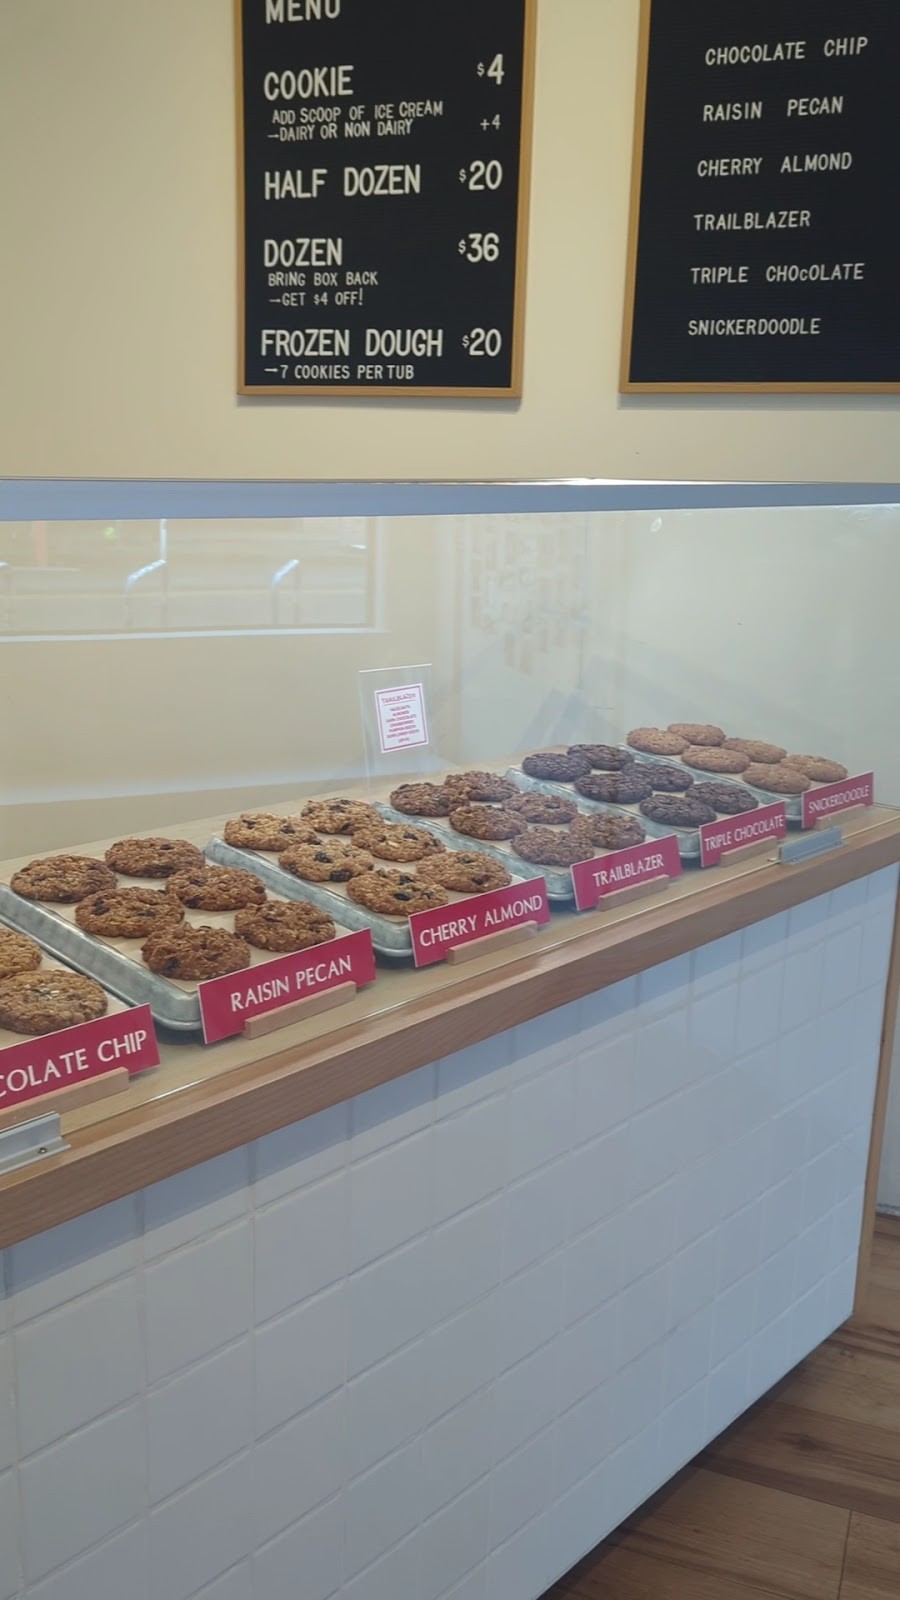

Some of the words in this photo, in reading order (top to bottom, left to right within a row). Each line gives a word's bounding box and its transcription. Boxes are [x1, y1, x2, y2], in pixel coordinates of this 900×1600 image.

[265, 0, 341, 24] MENU
[704, 40, 806, 66] CHOCOLATE
[823, 36, 869, 57] CHIP
[263, 64, 354, 101] COOKIE
[476, 53, 505, 85] $4
[271, 109, 296, 125] ADD
[299, 106, 342, 123] SCOOP
[348, 104, 366, 121] OF
[374, 103, 395, 120] ICE
[398, 99, 444, 118] CREAM
[702, 101, 763, 122] RAISIN
[786, 95, 844, 117] PECAN
[319, 122, 338, 140] OR
[344, 120, 371, 138] NON
[377, 118, 414, 137] DAIRY
[479, 114, 501, 131] +4
[697, 157, 763, 178] CHERRY
[780, 151, 853, 174] ALMOND
[264, 168, 328, 201] HALF
[343, 163, 421, 197] DOZEN
[459, 159, 503, 191] $20
[693, 210, 811, 231] TRAILBLAZER
[264, 237, 343, 268] DOZEN
[458, 232, 500, 263] $36
[268, 271, 306, 287] BRING
[313, 272, 338, 287] BOX
[345, 270, 379, 286] BACK
[690, 266, 749, 285] TRIPLE
[313, 291, 329, 306] $4
[334, 287, 364, 306] OFF!
[688, 317, 821, 336] SNICKERDOODLE
[261, 328, 350, 357] FROZEN
[365, 328, 443, 357] DOUGH
[461, 327, 502, 357] $20
[294, 364, 351, 380] COOKIES
[357, 364, 384, 380] PER
[386, 364, 415, 380] TUB
[807, 784, 870, 814] SNICKERDOODLE
[703, 831, 732, 851] TRIPLE
[733, 814, 785, 843] CHOCOLATE
[592, 853, 665, 887] TRAILBLAZER
[419, 914, 478, 947] CHERRY
[483, 894, 544, 928] ALMOND
[229, 975, 290, 1012] RAISIN
[295, 954, 353, 990] PECAN
[97, 1029, 147, 1062] CHIP
